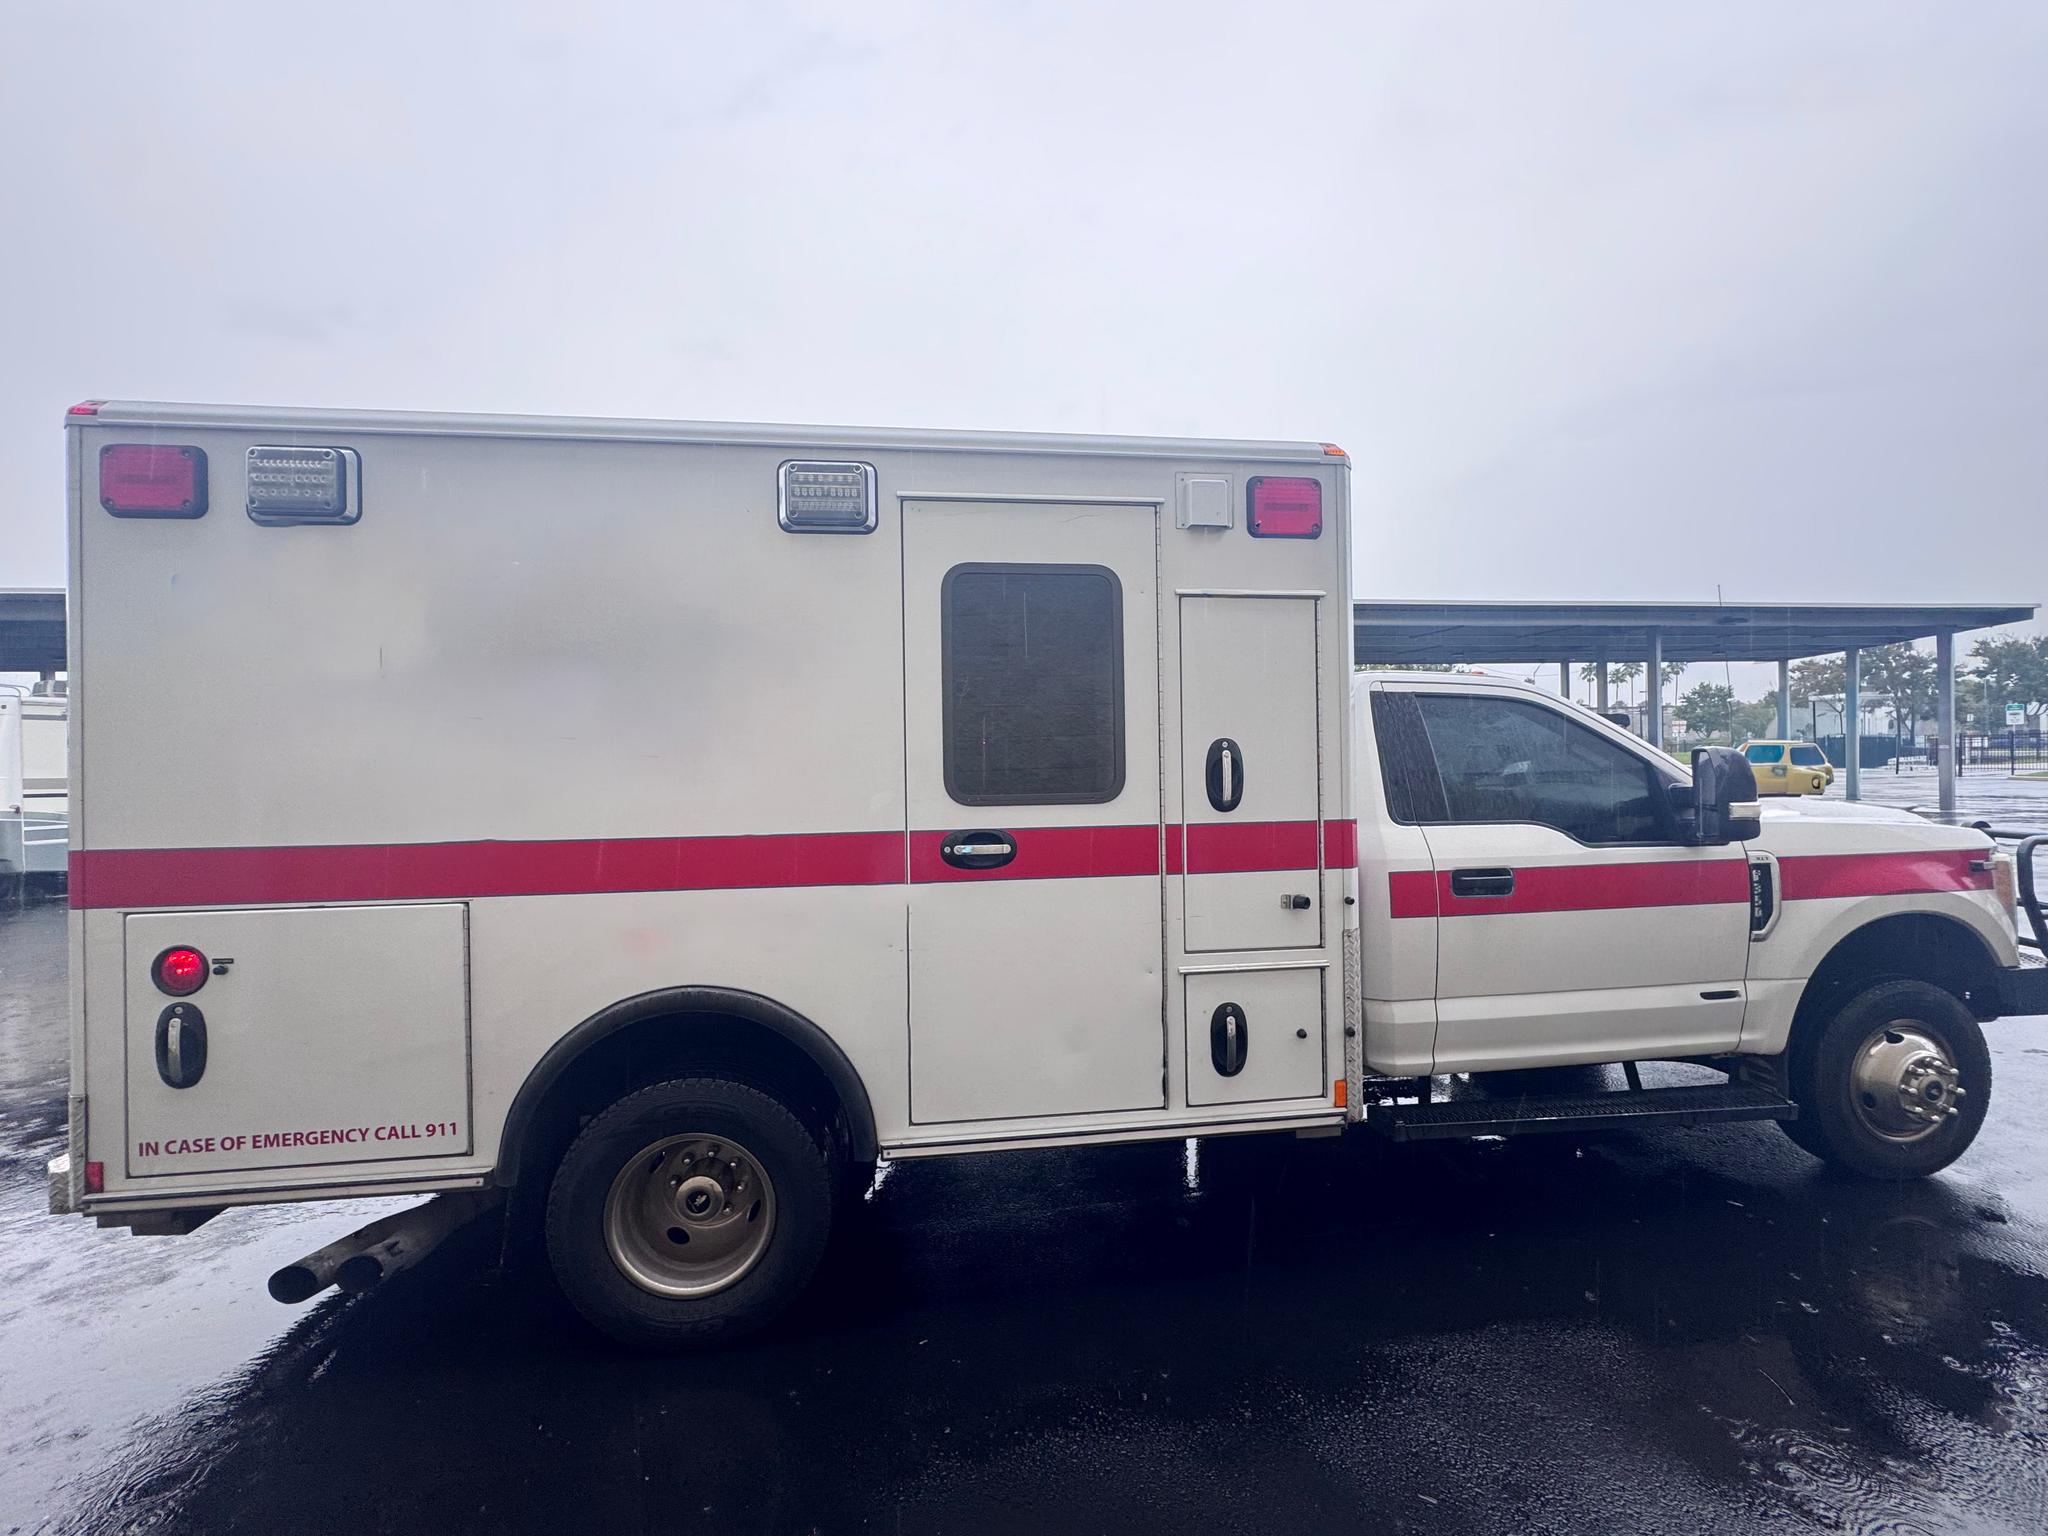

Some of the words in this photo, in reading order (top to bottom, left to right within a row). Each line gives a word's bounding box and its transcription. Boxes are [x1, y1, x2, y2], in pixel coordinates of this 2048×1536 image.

[138, 1141, 160, 1157] IN
[165, 1137, 215, 1155] CASE
[220, 1135, 246, 1151] OF
[252, 1127, 369, 1149] EMERGENCY
[375, 1124, 421, 1140] CALL
[425, 1122, 457, 1137] 911
